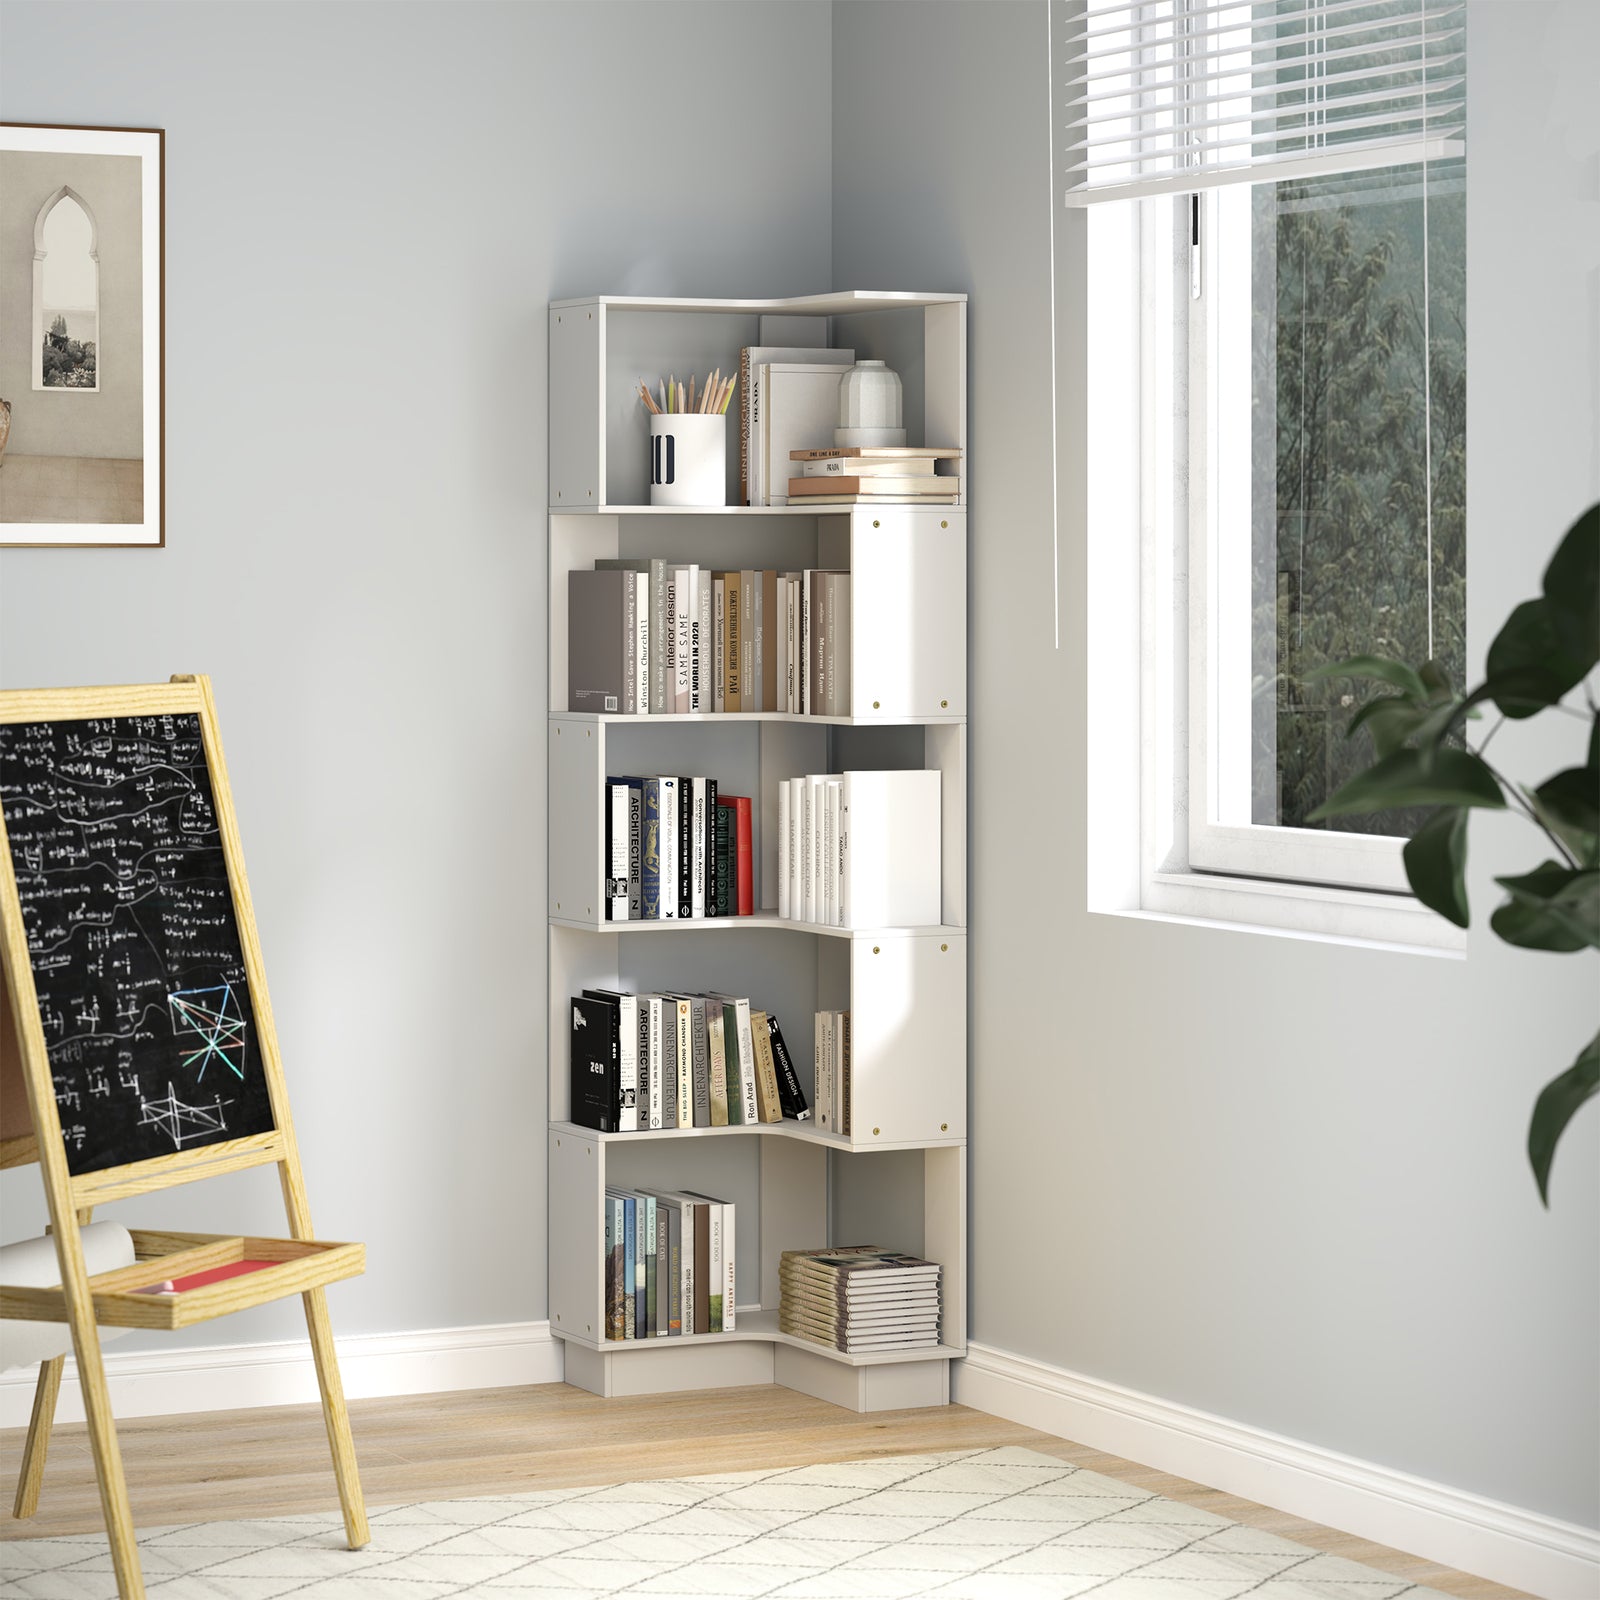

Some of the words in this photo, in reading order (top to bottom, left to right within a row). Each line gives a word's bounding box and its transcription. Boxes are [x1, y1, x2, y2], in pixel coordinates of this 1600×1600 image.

[658, 598, 664, 607] in
[666, 584, 675, 624] design
[730, 590, 738, 640] БОЖЕСТВЕННАЯ
[680, 614, 688, 646] SAME
[658, 654, 664, 664] an
[666, 628, 675, 669] Interior
[692, 647, 699, 656] IN
[730, 640, 738, 670] КОМЕДИЯ
[680, 654, 688, 686] SAME
[730, 674, 739, 694] РАЙ
[658, 684, 664, 693] to
[640, 1008, 648, 1095] ARCHITECTURE
[694, 1007, 706, 1108] INNENARCHITEKTUR
[713, 1050, 722, 1072] DAYS
[590, 1061, 604, 1075] zen
[666, 1022, 674, 1120] INNENARCHITEKTUR
[776, 1042, 790, 1072] FASHION
[786, 1072, 798, 1096] DESIGN
[714, 1073, 724, 1098] AFTER
[746, 1082, 754, 1100] Arad
